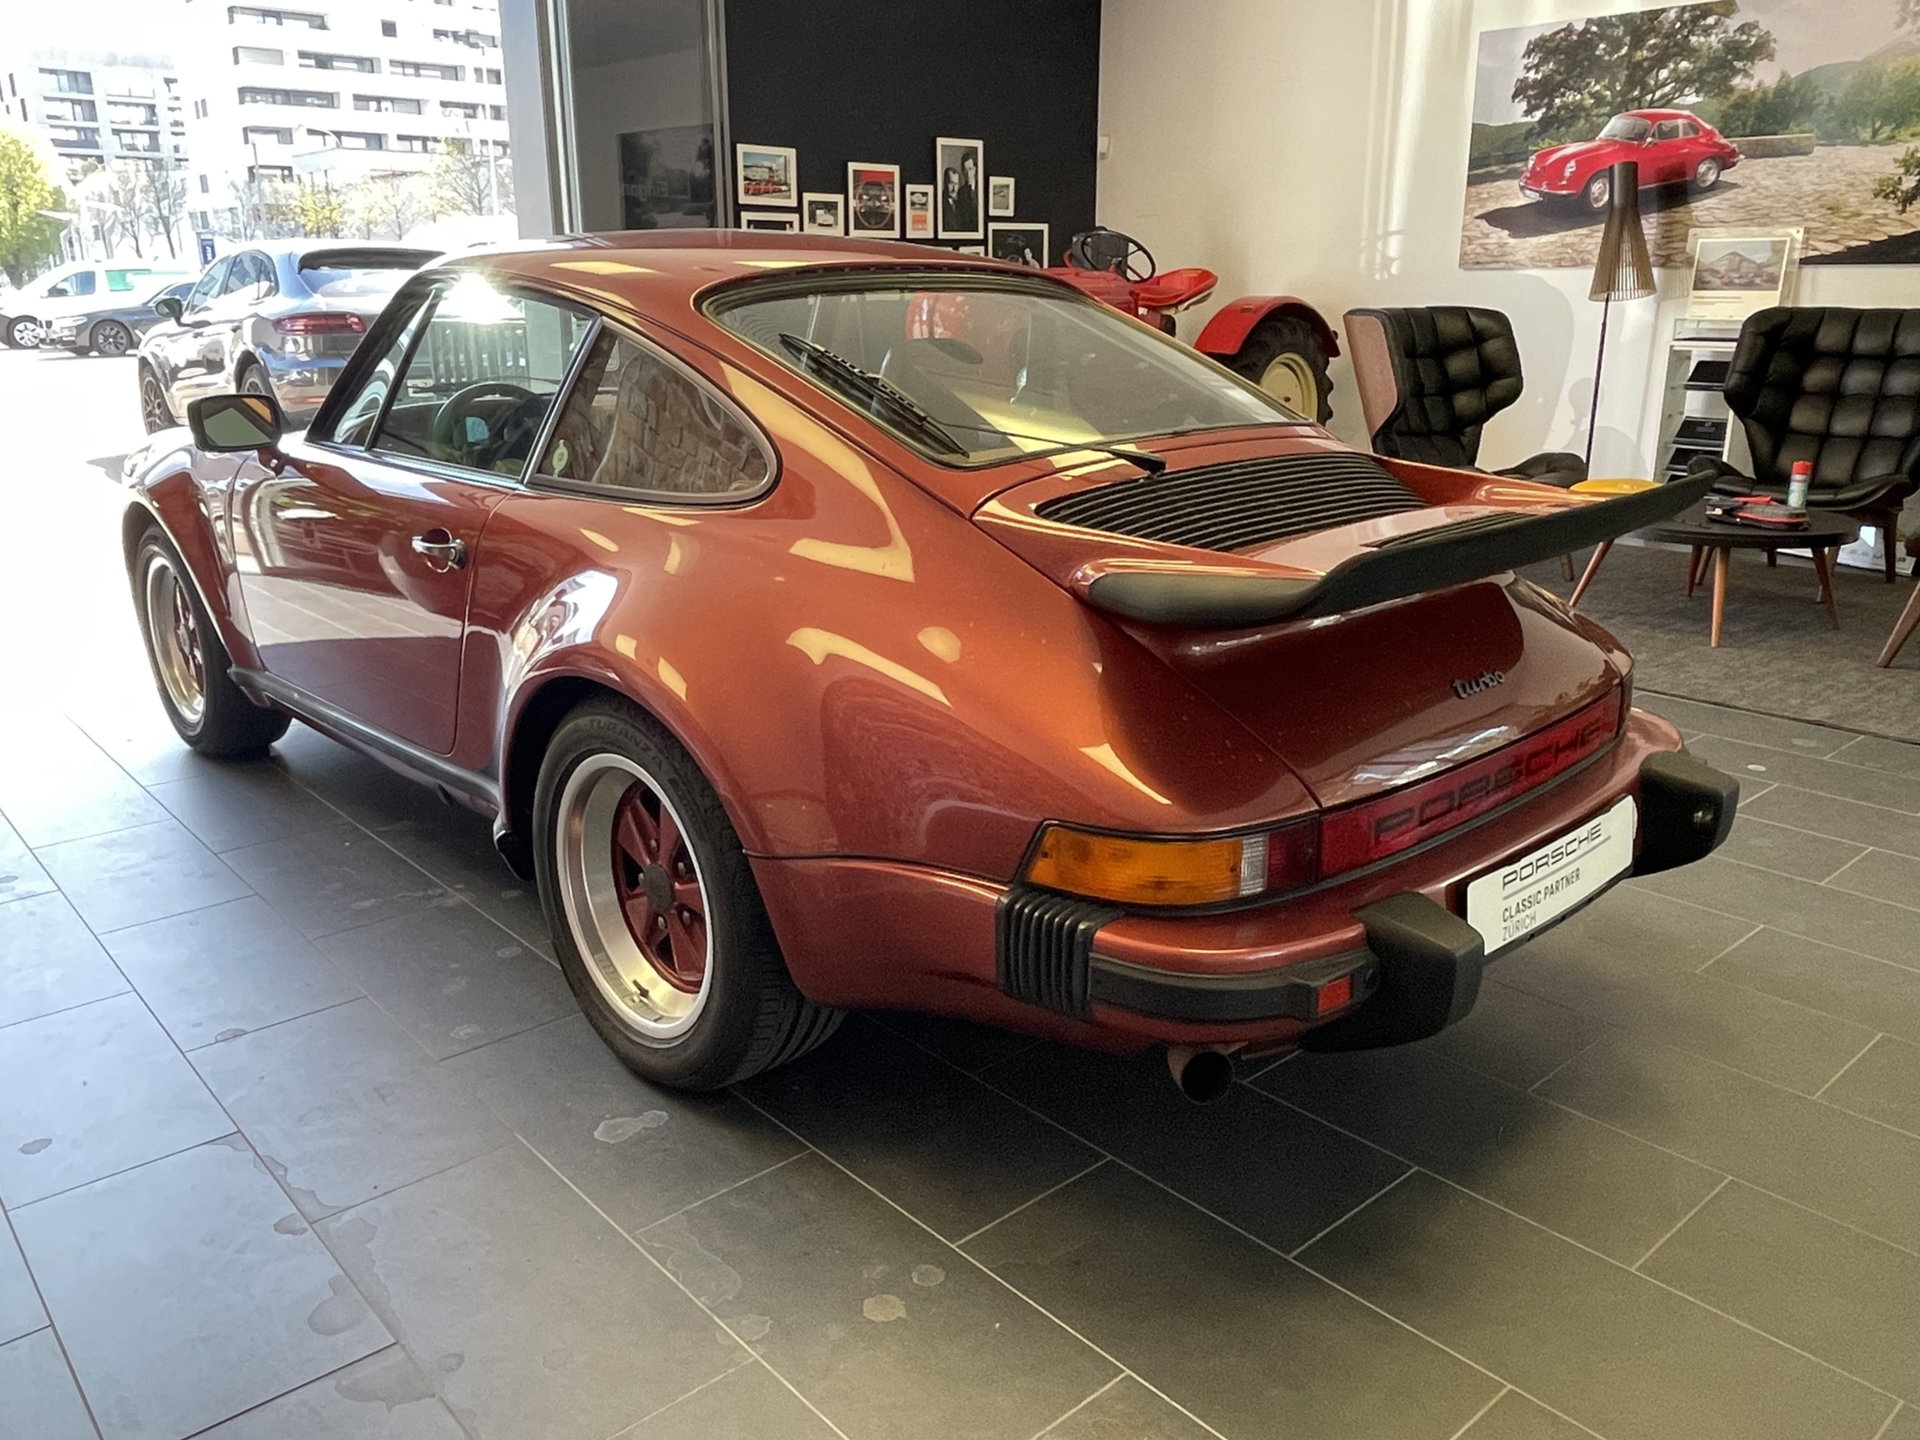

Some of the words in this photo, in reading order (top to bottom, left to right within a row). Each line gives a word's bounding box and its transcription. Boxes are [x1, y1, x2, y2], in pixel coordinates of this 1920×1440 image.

[1452, 670, 1505, 699] turbo
[1371, 722, 1602, 846] PORSCHE
[1502, 823, 1602, 890] PORSCHE
[1502, 891, 1541, 923] CLASSIC
[1543, 868, 1581, 901] PARTNER
